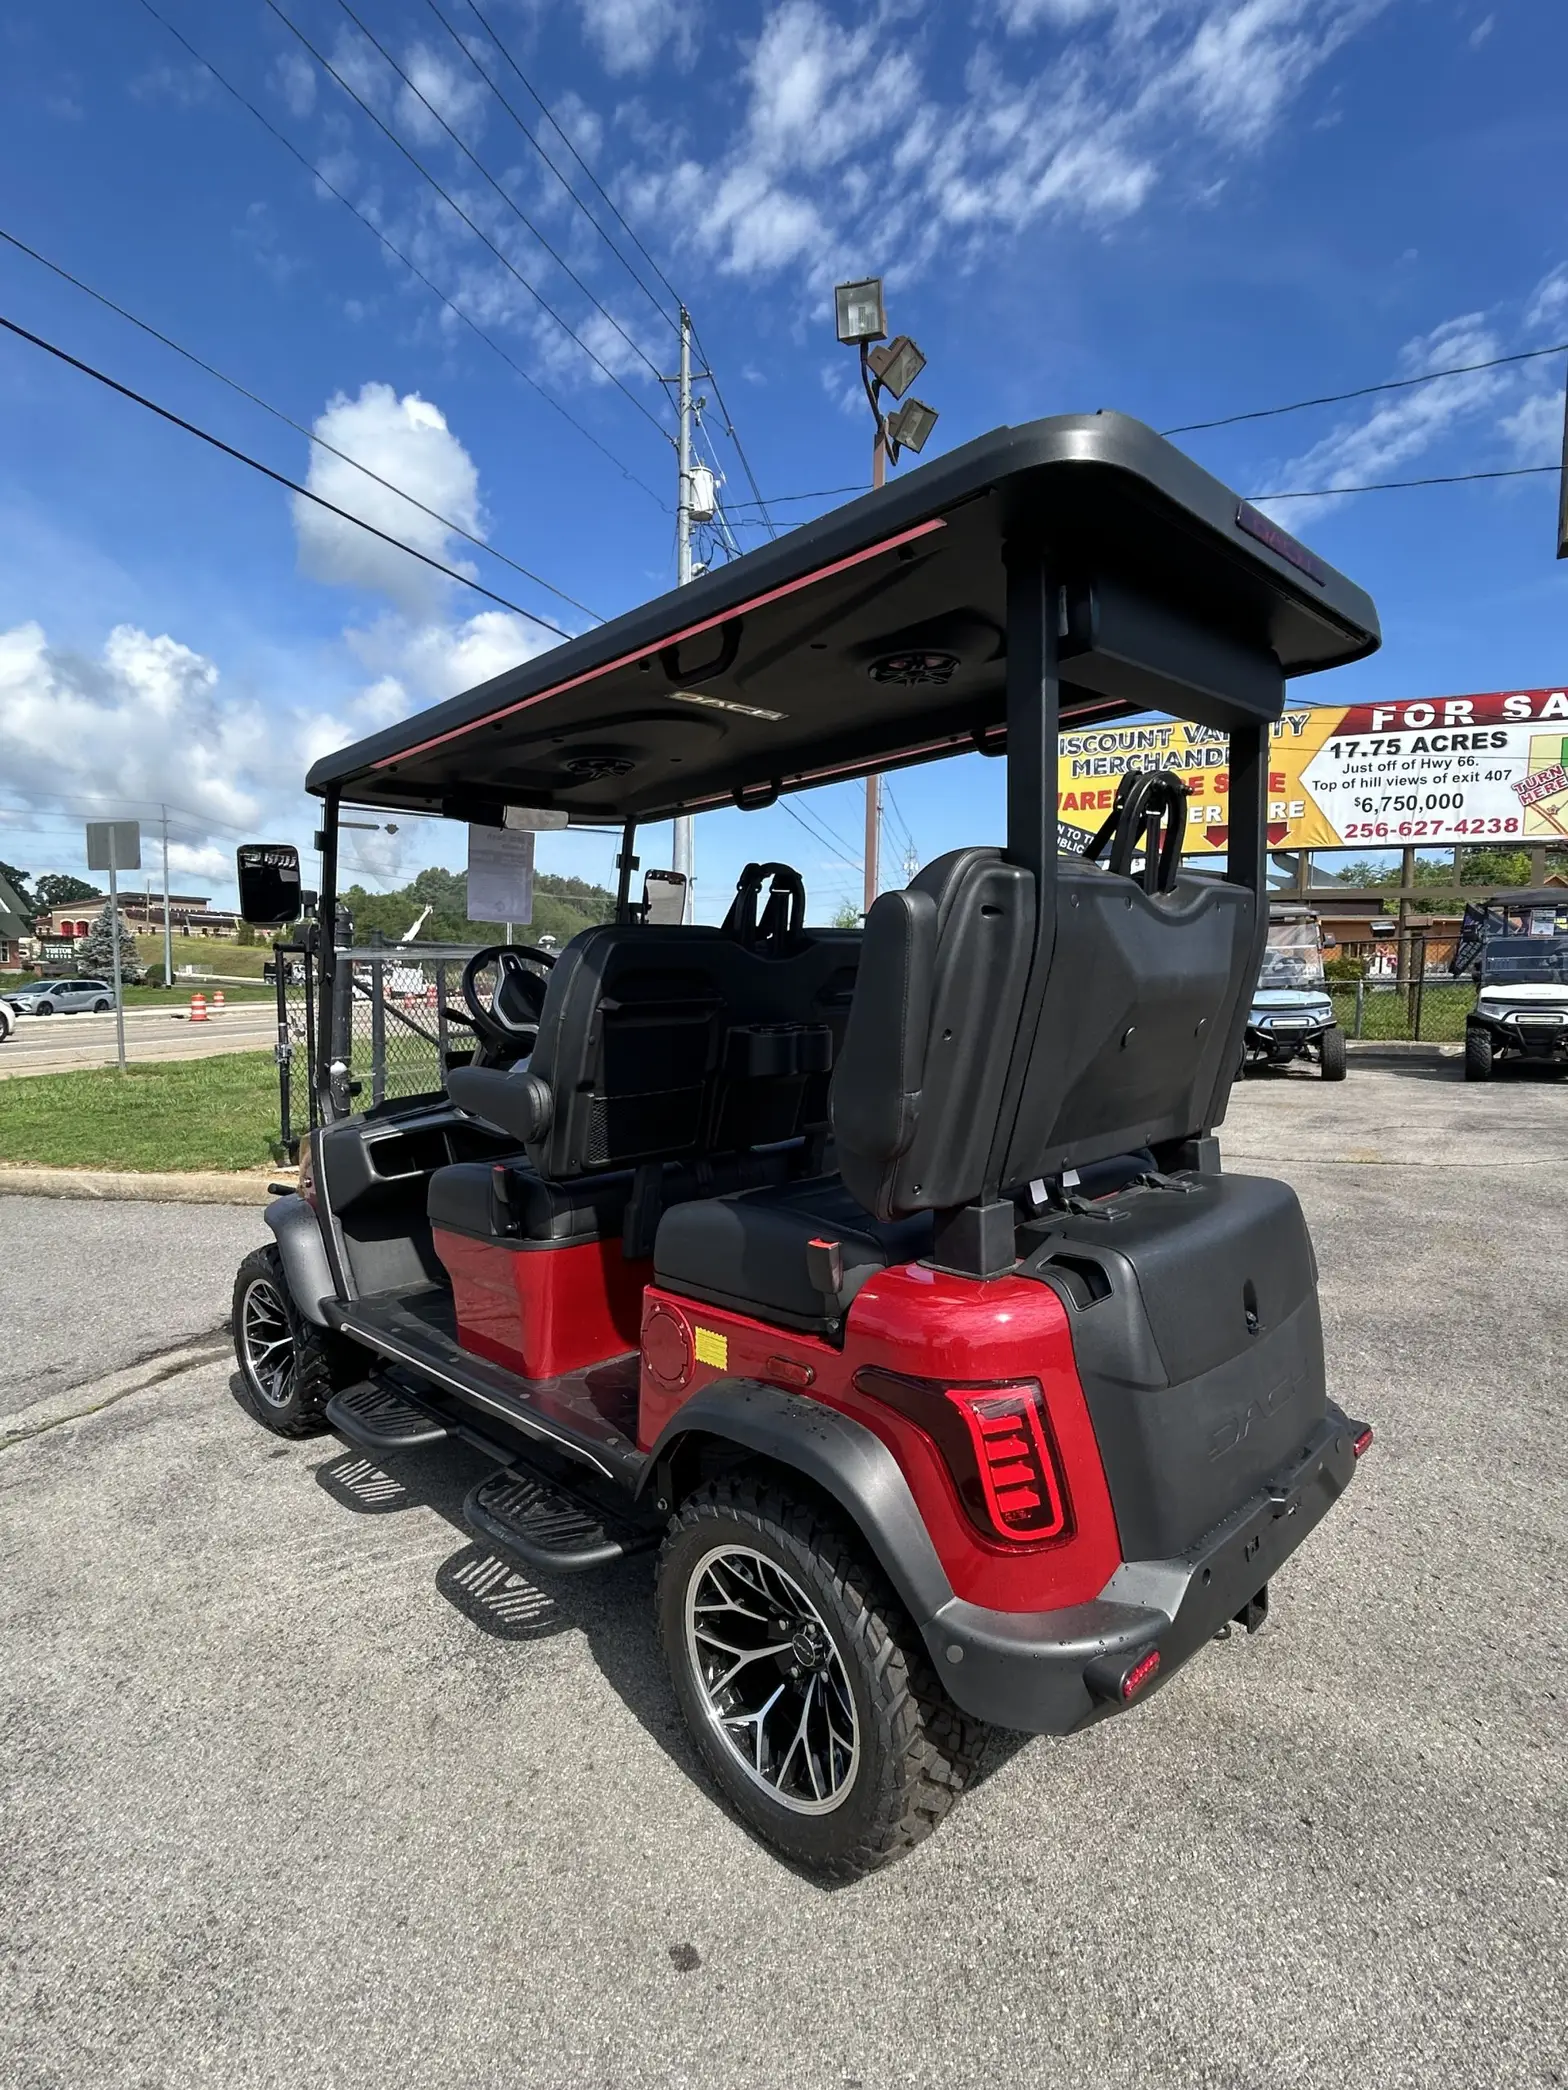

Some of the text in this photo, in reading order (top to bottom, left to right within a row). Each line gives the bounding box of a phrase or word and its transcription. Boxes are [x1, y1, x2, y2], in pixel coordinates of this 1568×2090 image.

[1372, 692, 1568, 731] FOR SA
[1059, 712, 1310, 756] ISCOUNT VATY
[1330, 731, 1508, 759] 17.75 ACRES
[1342, 755, 1479, 774] Just off of Hwy 66.
[1312, 769, 1512, 791] Top of hill views of exit 407
[1513, 765, 1563, 793] TURN
[1521, 777, 1566, 805] HERE
[1354, 793, 1464, 815] $6,750,000
[1067, 828, 1081, 840] TO
[1344, 817, 1519, 839] 256-627-4238
[1057, 836, 1085, 854] BLIC
